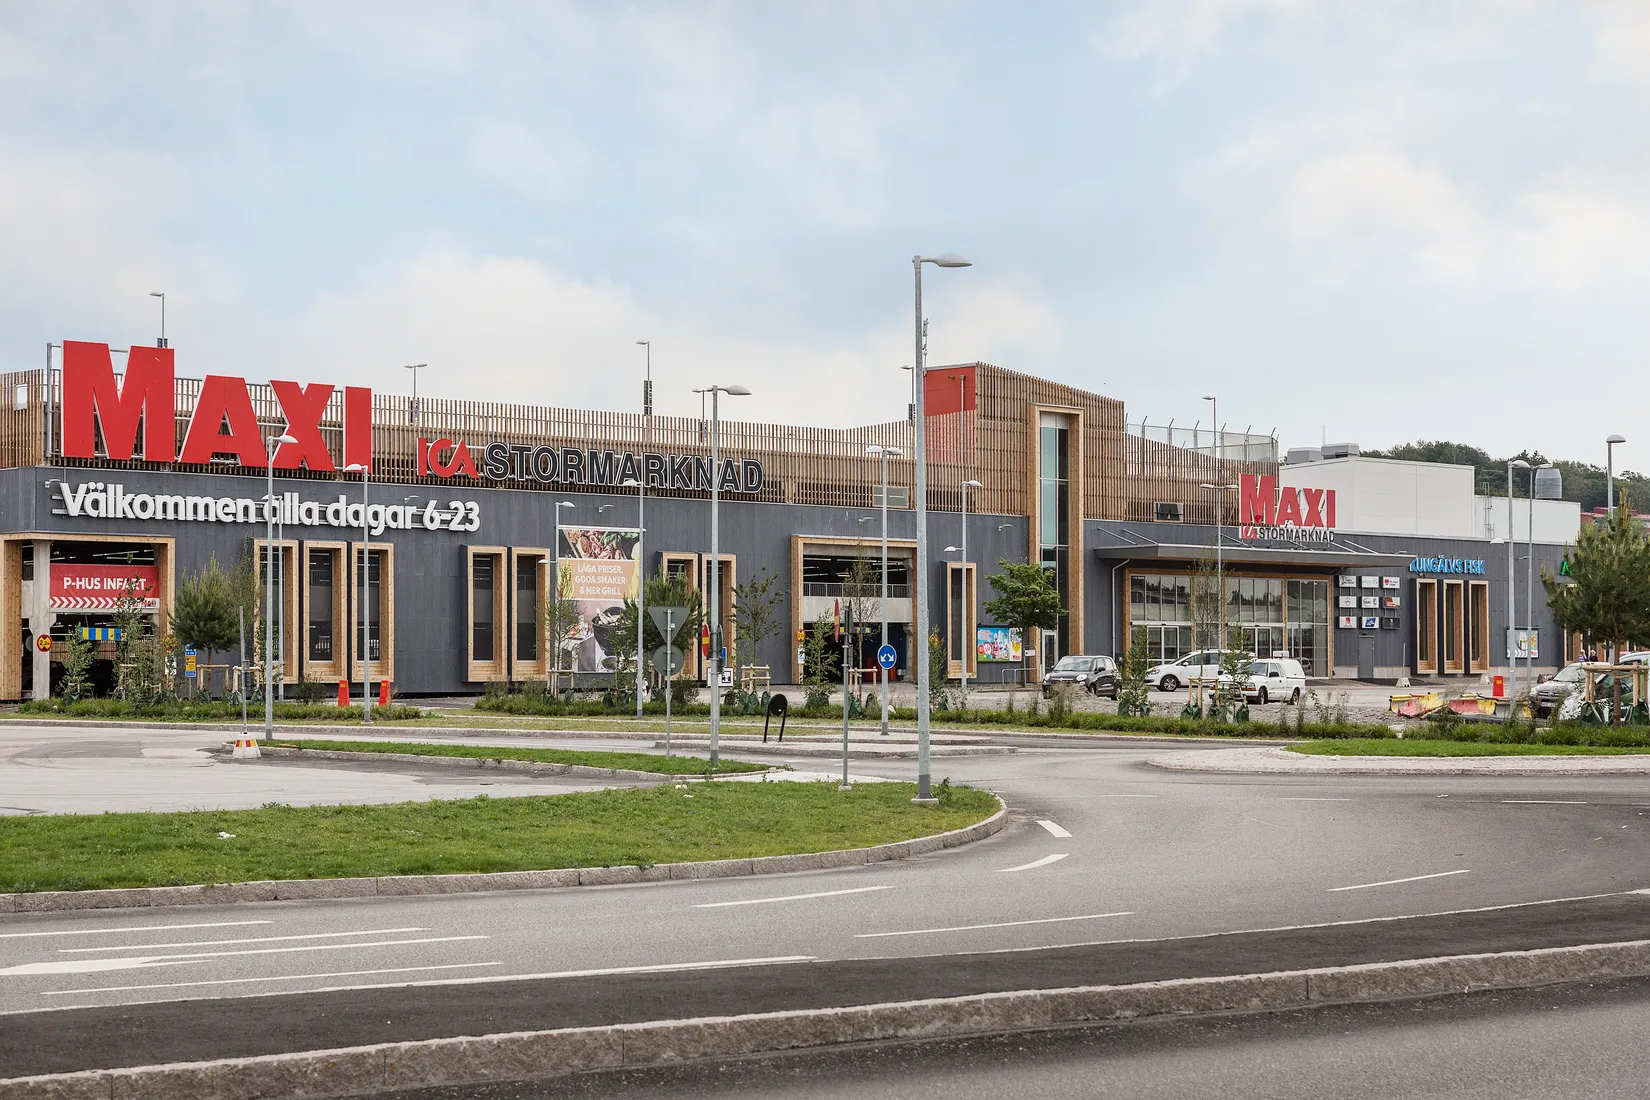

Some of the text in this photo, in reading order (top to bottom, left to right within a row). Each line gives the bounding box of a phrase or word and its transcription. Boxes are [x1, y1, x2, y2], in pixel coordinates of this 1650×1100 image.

[61, 340, 372, 472] MAXI
[416, 437, 764, 493] ICA STORMARKNAD
[60, 481, 480, 536] Välkommen alla dagar 6-23
[1239, 473, 1336, 528] MAXI
[1258, 527, 1336, 543] STORMARKNAD
[578, 563, 623, 574] LÅGA PRISER,
[1409, 554, 1486, 575] KUNGÄLVS FISK
[63, 576, 101, 590] P-HUS
[575, 575, 626, 585] GODA SMAKER
[579, 586, 622, 596] & MER GRILL
